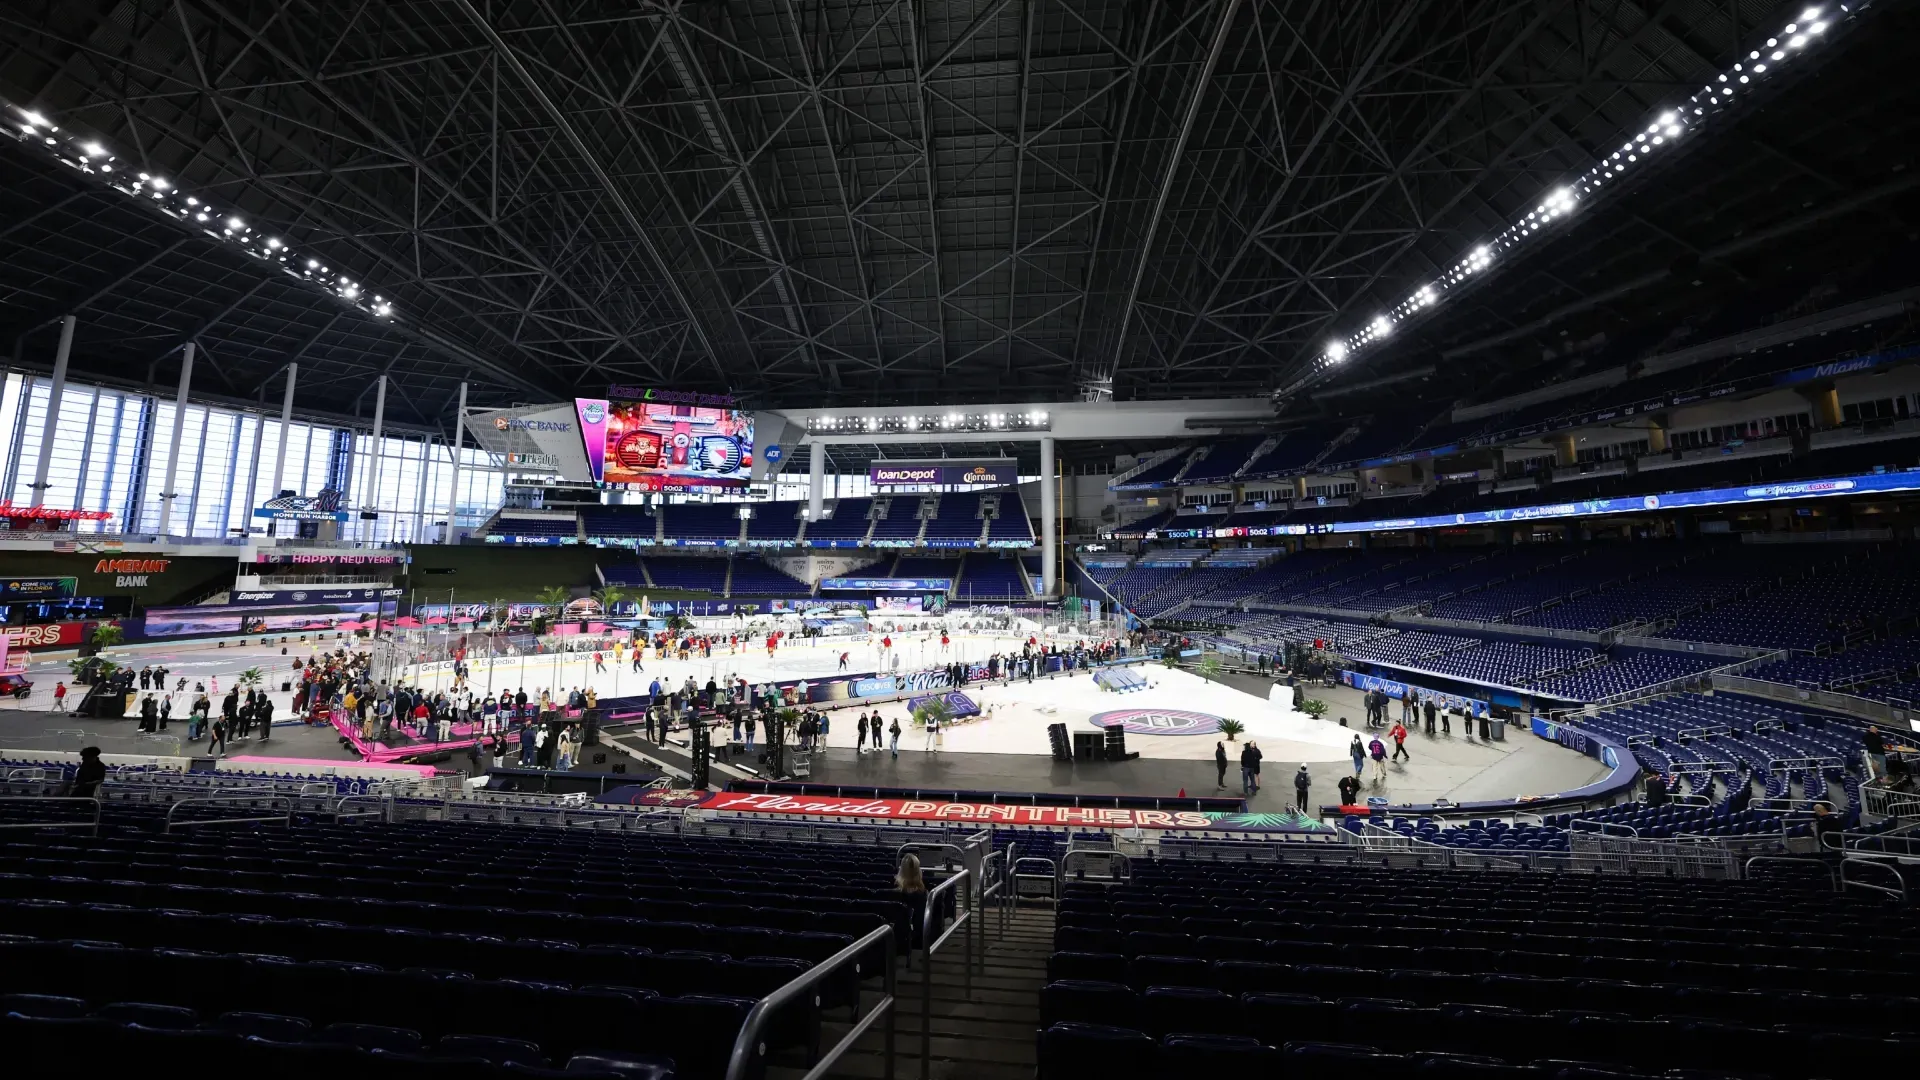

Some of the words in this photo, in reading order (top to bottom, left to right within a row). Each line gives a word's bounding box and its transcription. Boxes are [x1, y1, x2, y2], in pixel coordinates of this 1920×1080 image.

[1814, 356, 1872, 378] Miami
[608, 383, 698, 404] loanDepot
[698, 393, 735, 406] park
[509, 419, 540, 430] PNC
[540, 421, 572, 433] BANK
[692, 436, 704, 471] NYR
[766, 450, 781, 458] ADT
[877, 469, 936, 482] loanDepot
[963, 472, 997, 484] Corona
[1773, 485, 1807, 497] Winter
[0, 498, 114, 521] udweiser
[1539, 505, 1575, 516] RANGERS
[1249, 528, 1268, 536] 50:02
[292, 555, 335, 564] HAPPY
[340, 555, 365, 564] NEW
[367, 555, 394, 564] YEAR!
[94, 559, 169, 574] AMERANT
[116, 575, 149, 587] BANK
[237, 592, 276, 601] Energizer
[0, 625, 62, 647] ERS
[576, 651, 614, 661] DISCVER
[859, 681, 892, 692] DISCOVER
[1361, 677, 1380, 691] New
[1379, 678, 1404, 695] York
[1408, 686, 1473, 709] ANGERS
[1558, 726, 1587, 753] NYR
[716, 794, 893, 815] Florida
[898, 801, 1212, 828] PANTHERS
